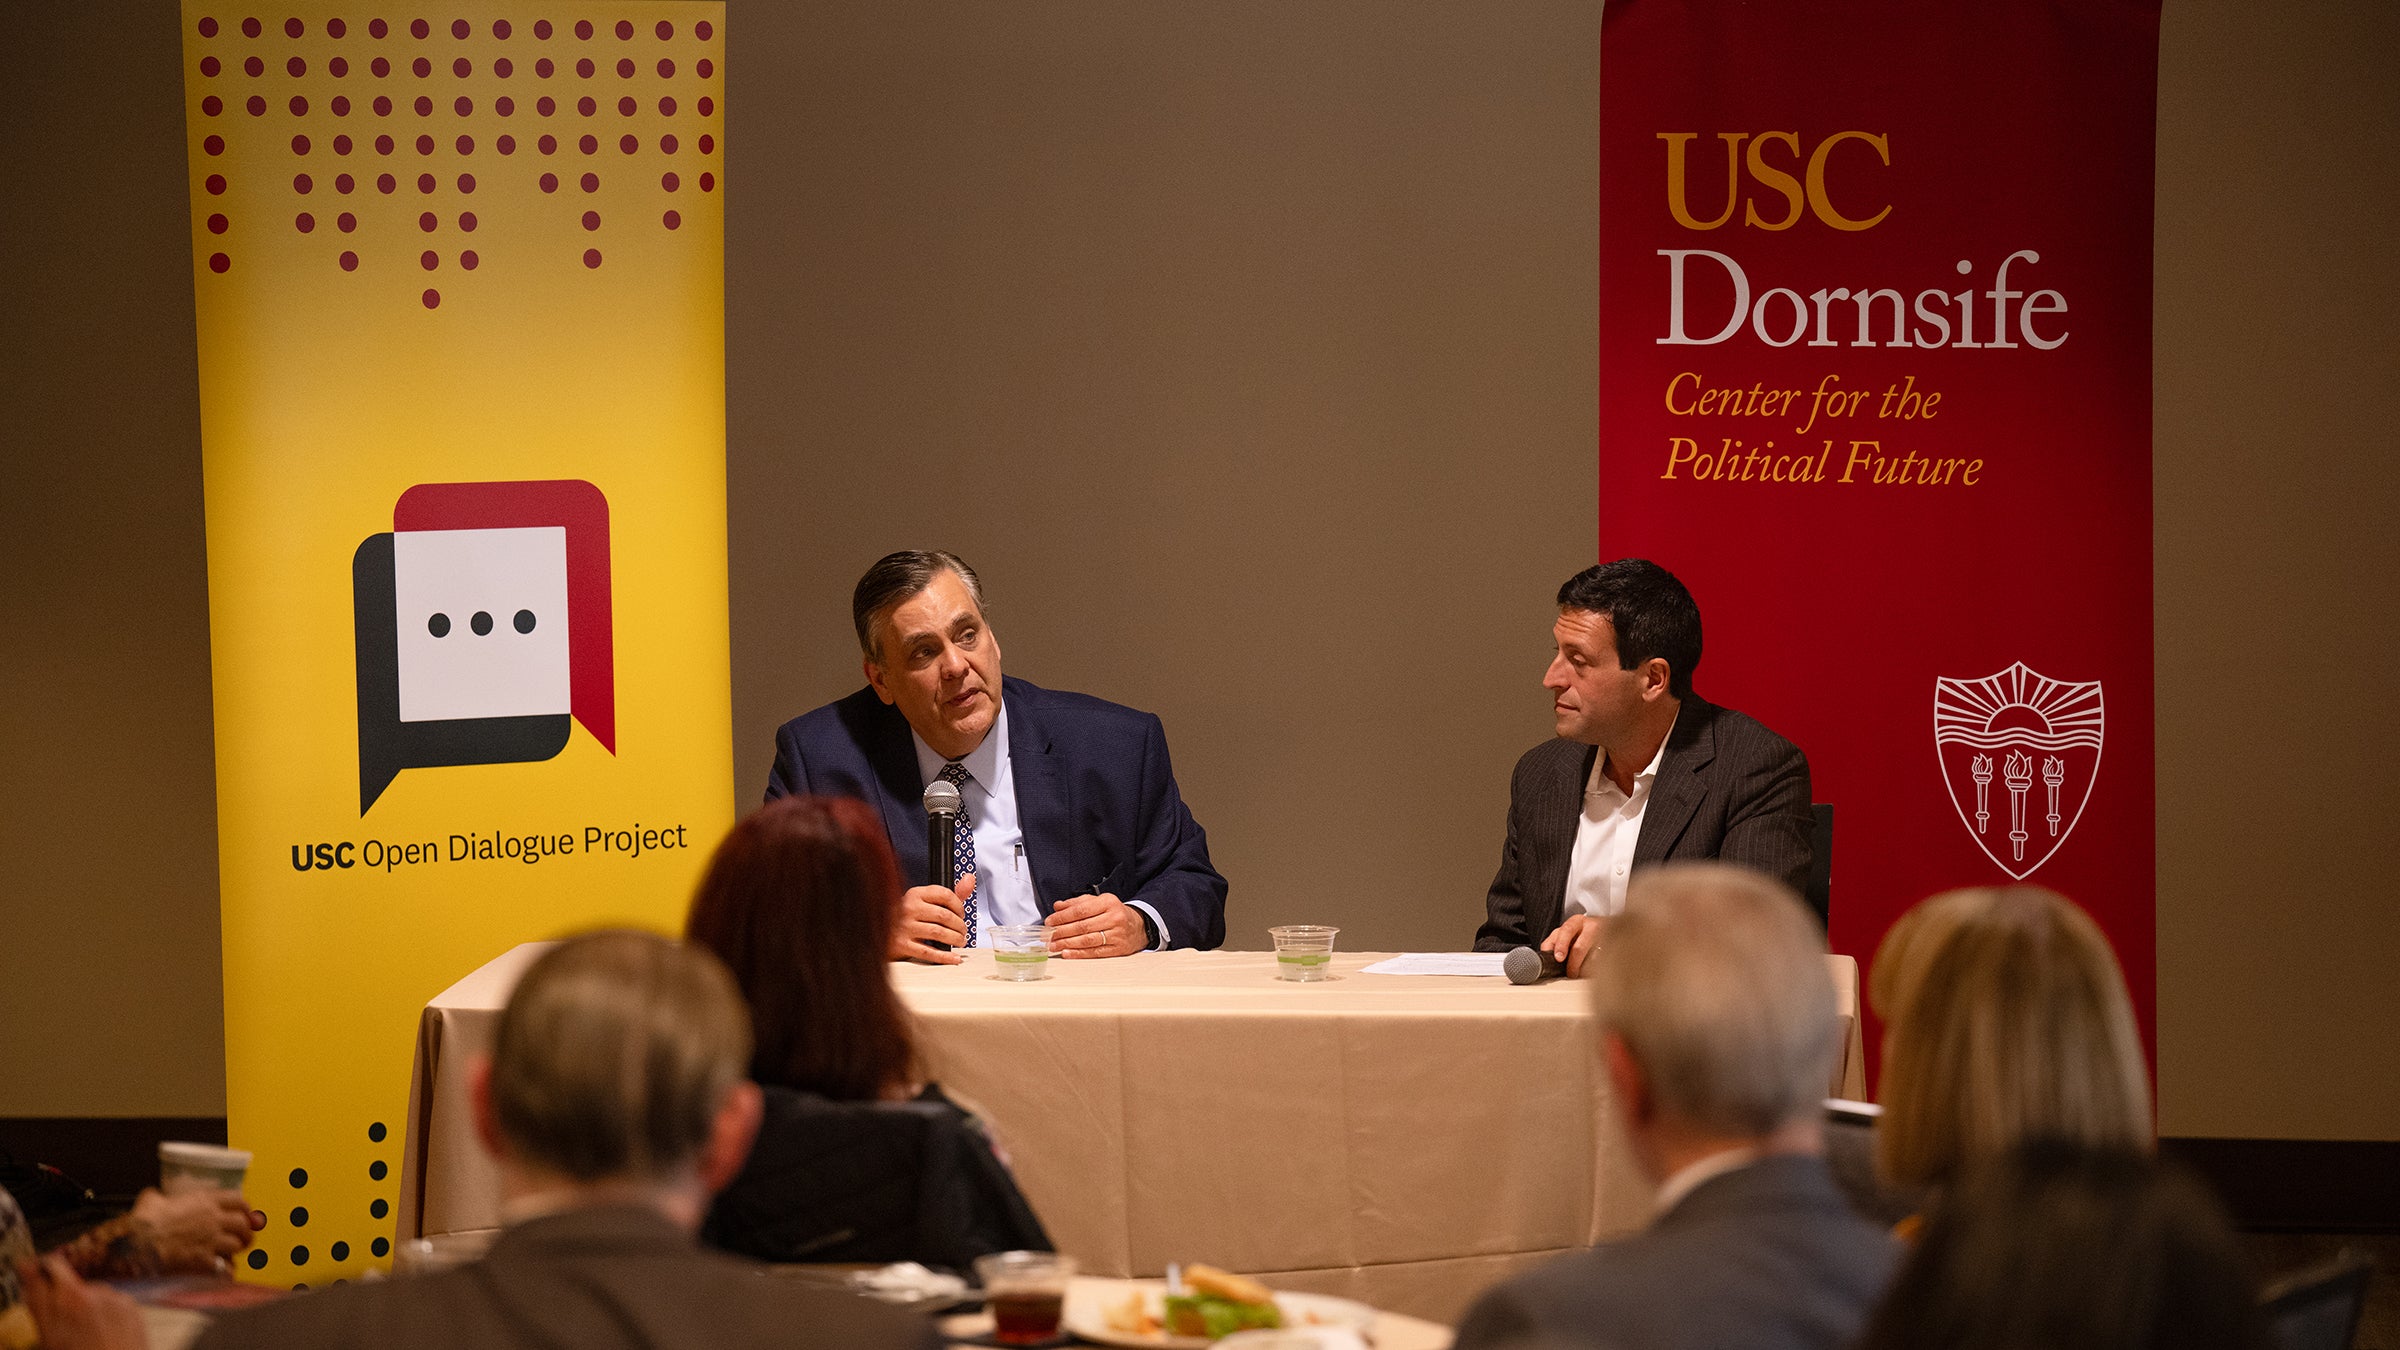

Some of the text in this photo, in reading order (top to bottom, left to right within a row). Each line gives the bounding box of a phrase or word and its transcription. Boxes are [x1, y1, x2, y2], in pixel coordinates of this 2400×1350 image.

[1655, 130, 1893, 232] USC
[1655, 248, 2070, 351] Dornsife
[1664, 371, 1942, 435] Center for the
[1659, 437, 1984, 486] Political Future
[290, 823, 689, 873] USC Open Dialogue Project
